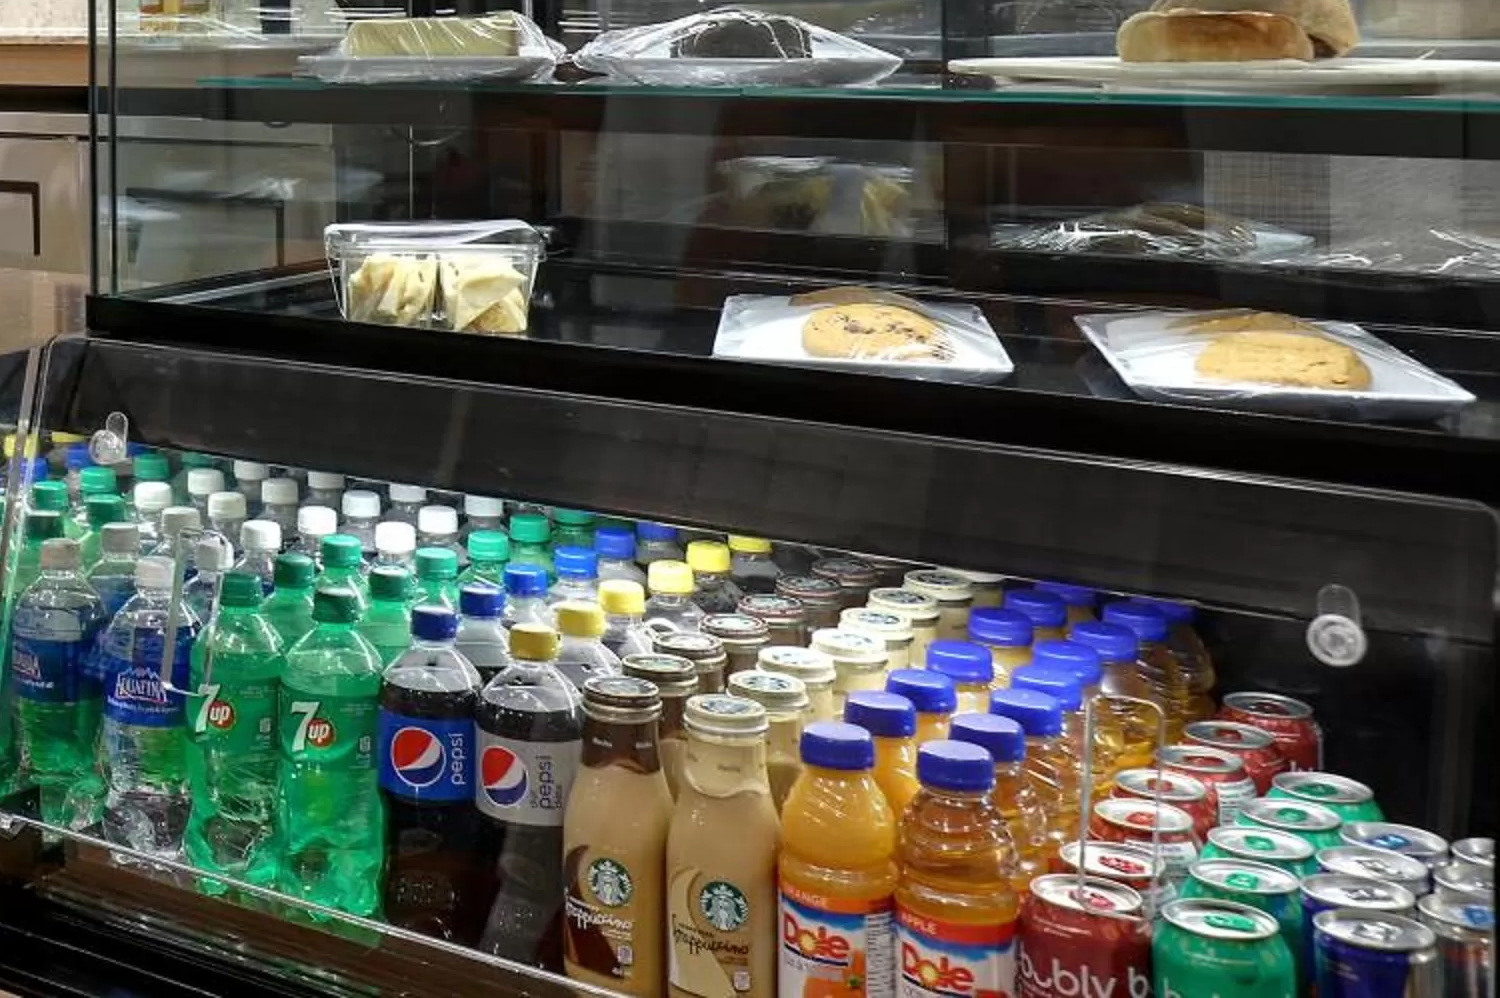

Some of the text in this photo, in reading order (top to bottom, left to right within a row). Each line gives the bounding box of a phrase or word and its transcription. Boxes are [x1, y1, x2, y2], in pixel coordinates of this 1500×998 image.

[448, 732, 466, 786] pepsi
[535, 755, 557, 810] pepsi
[783, 912, 851, 959] Dole
[901, 940, 975, 992] Dole
